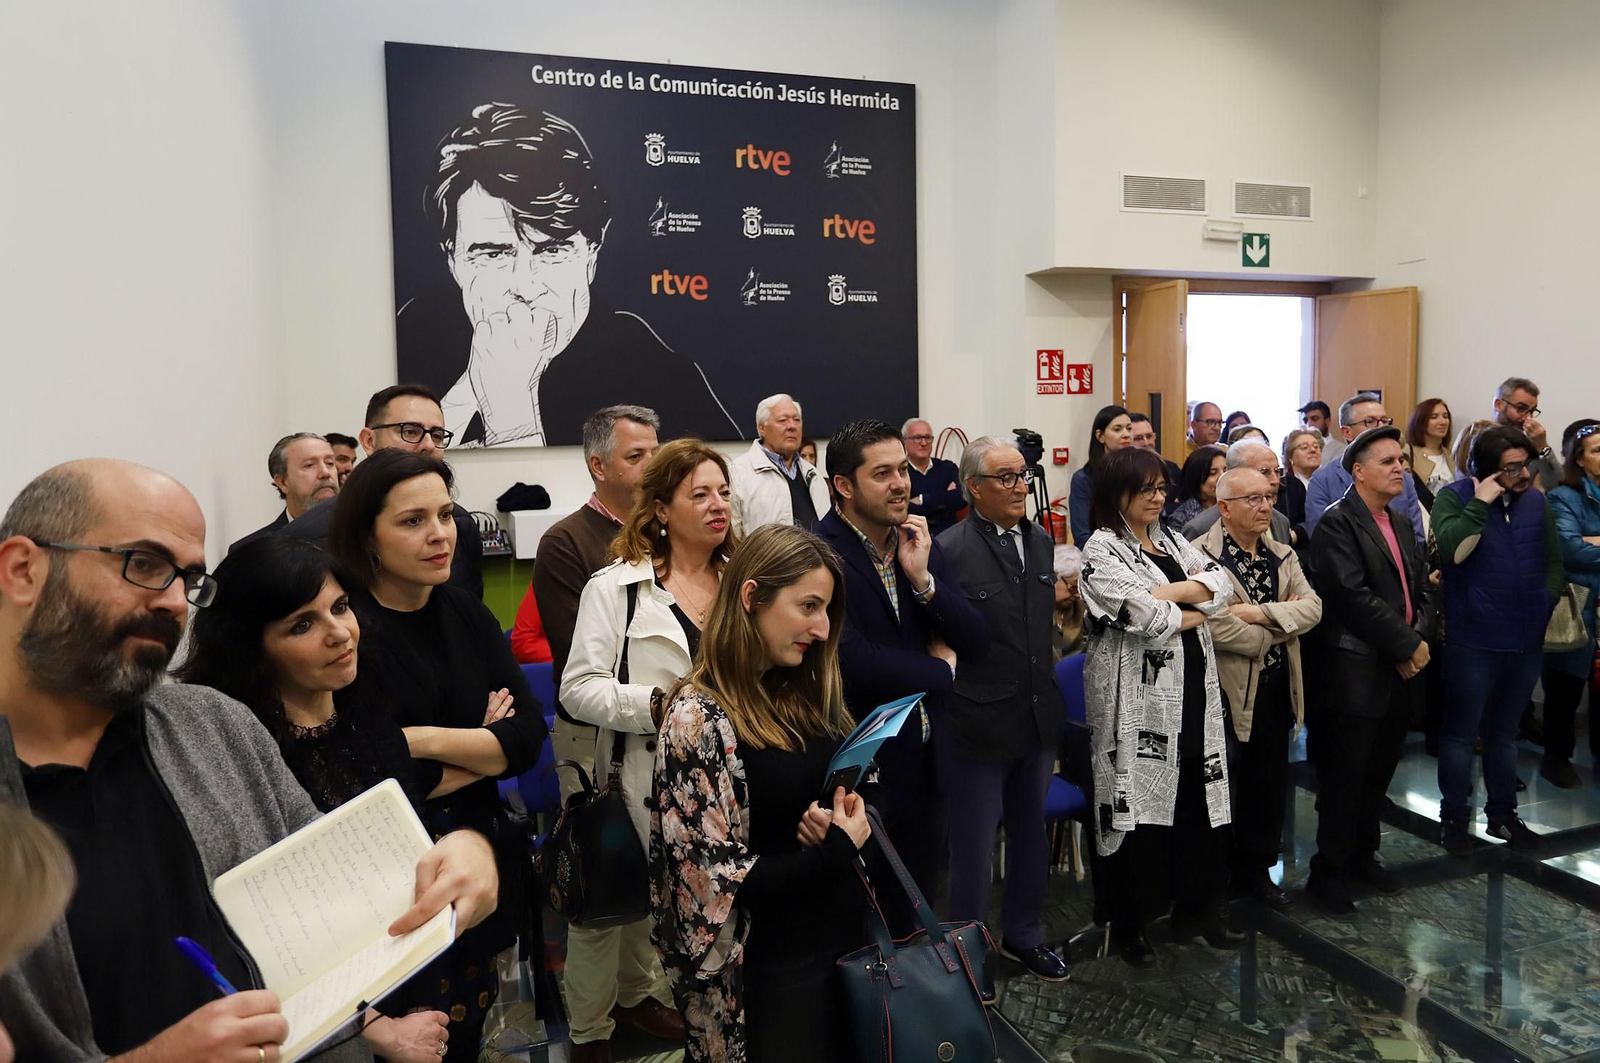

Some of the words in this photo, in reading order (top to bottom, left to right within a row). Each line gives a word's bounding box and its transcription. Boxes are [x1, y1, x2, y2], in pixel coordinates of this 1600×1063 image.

[531, 64, 596, 89] Centro
[600, 69, 624, 90] de
[627, 70, 645, 91] la
[649, 73, 774, 100] Comunicación
[777, 83, 826, 105] Jesús
[830, 88, 900, 111] Hermida
[667, 155, 701, 164] HUELVA
[735, 144, 791, 176] rtve
[763, 227, 795, 236] HUELVA
[823, 214, 876, 244] rtve
[651, 269, 709, 300] rtve
[847, 294, 878, 302] HUELVA
[1037, 384, 1063, 393] EXTINTOR
